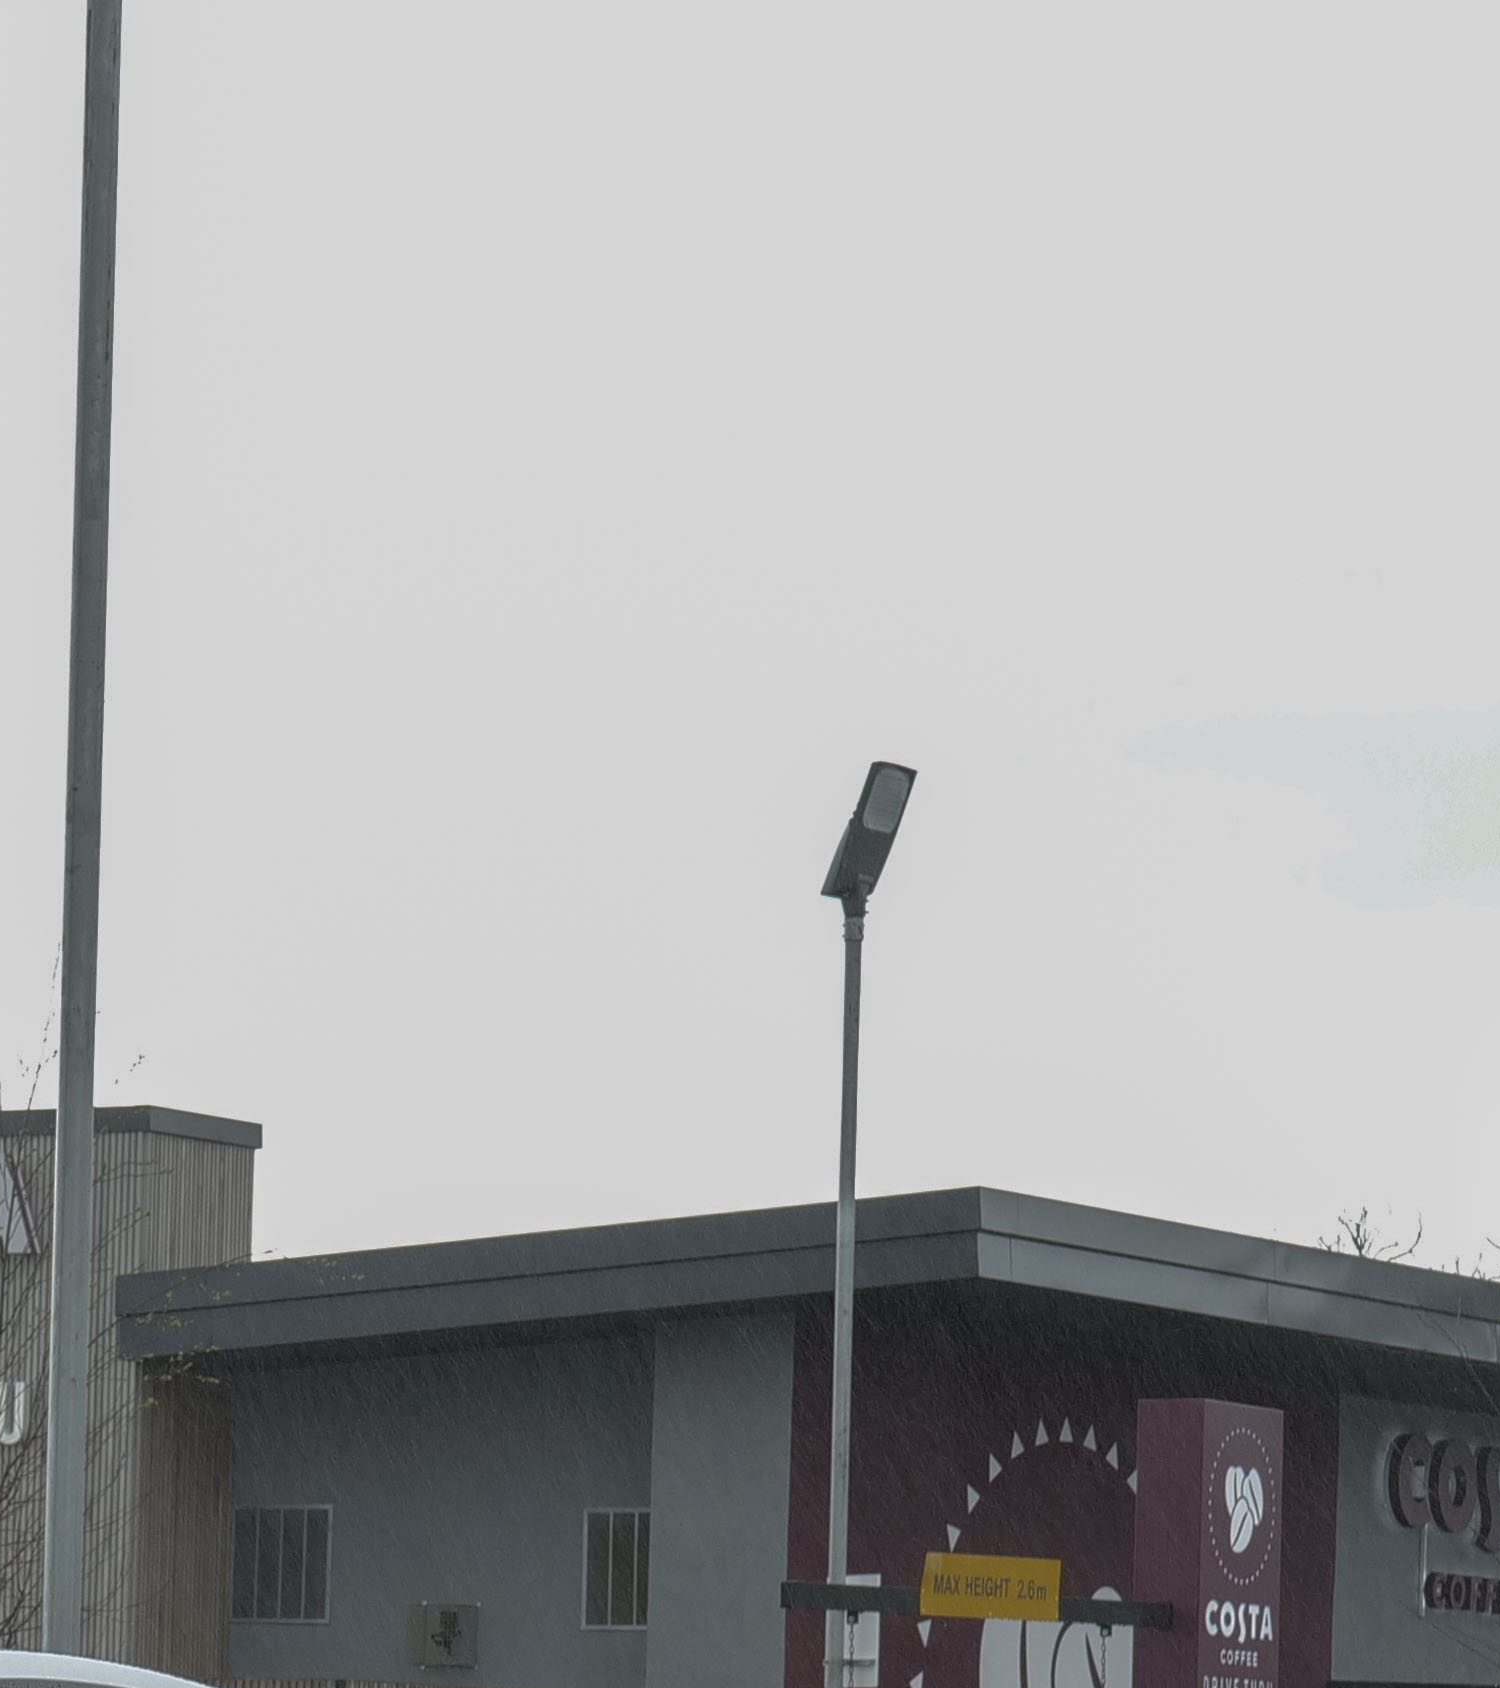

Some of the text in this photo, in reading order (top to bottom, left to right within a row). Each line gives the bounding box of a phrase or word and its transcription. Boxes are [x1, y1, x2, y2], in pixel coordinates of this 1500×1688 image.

[933, 1574, 1047, 1600] MAX HEIGHT 2.6m
[1205, 1599, 1273, 1644] COSTA
[1220, 1648, 1259, 1668] COFFEE
